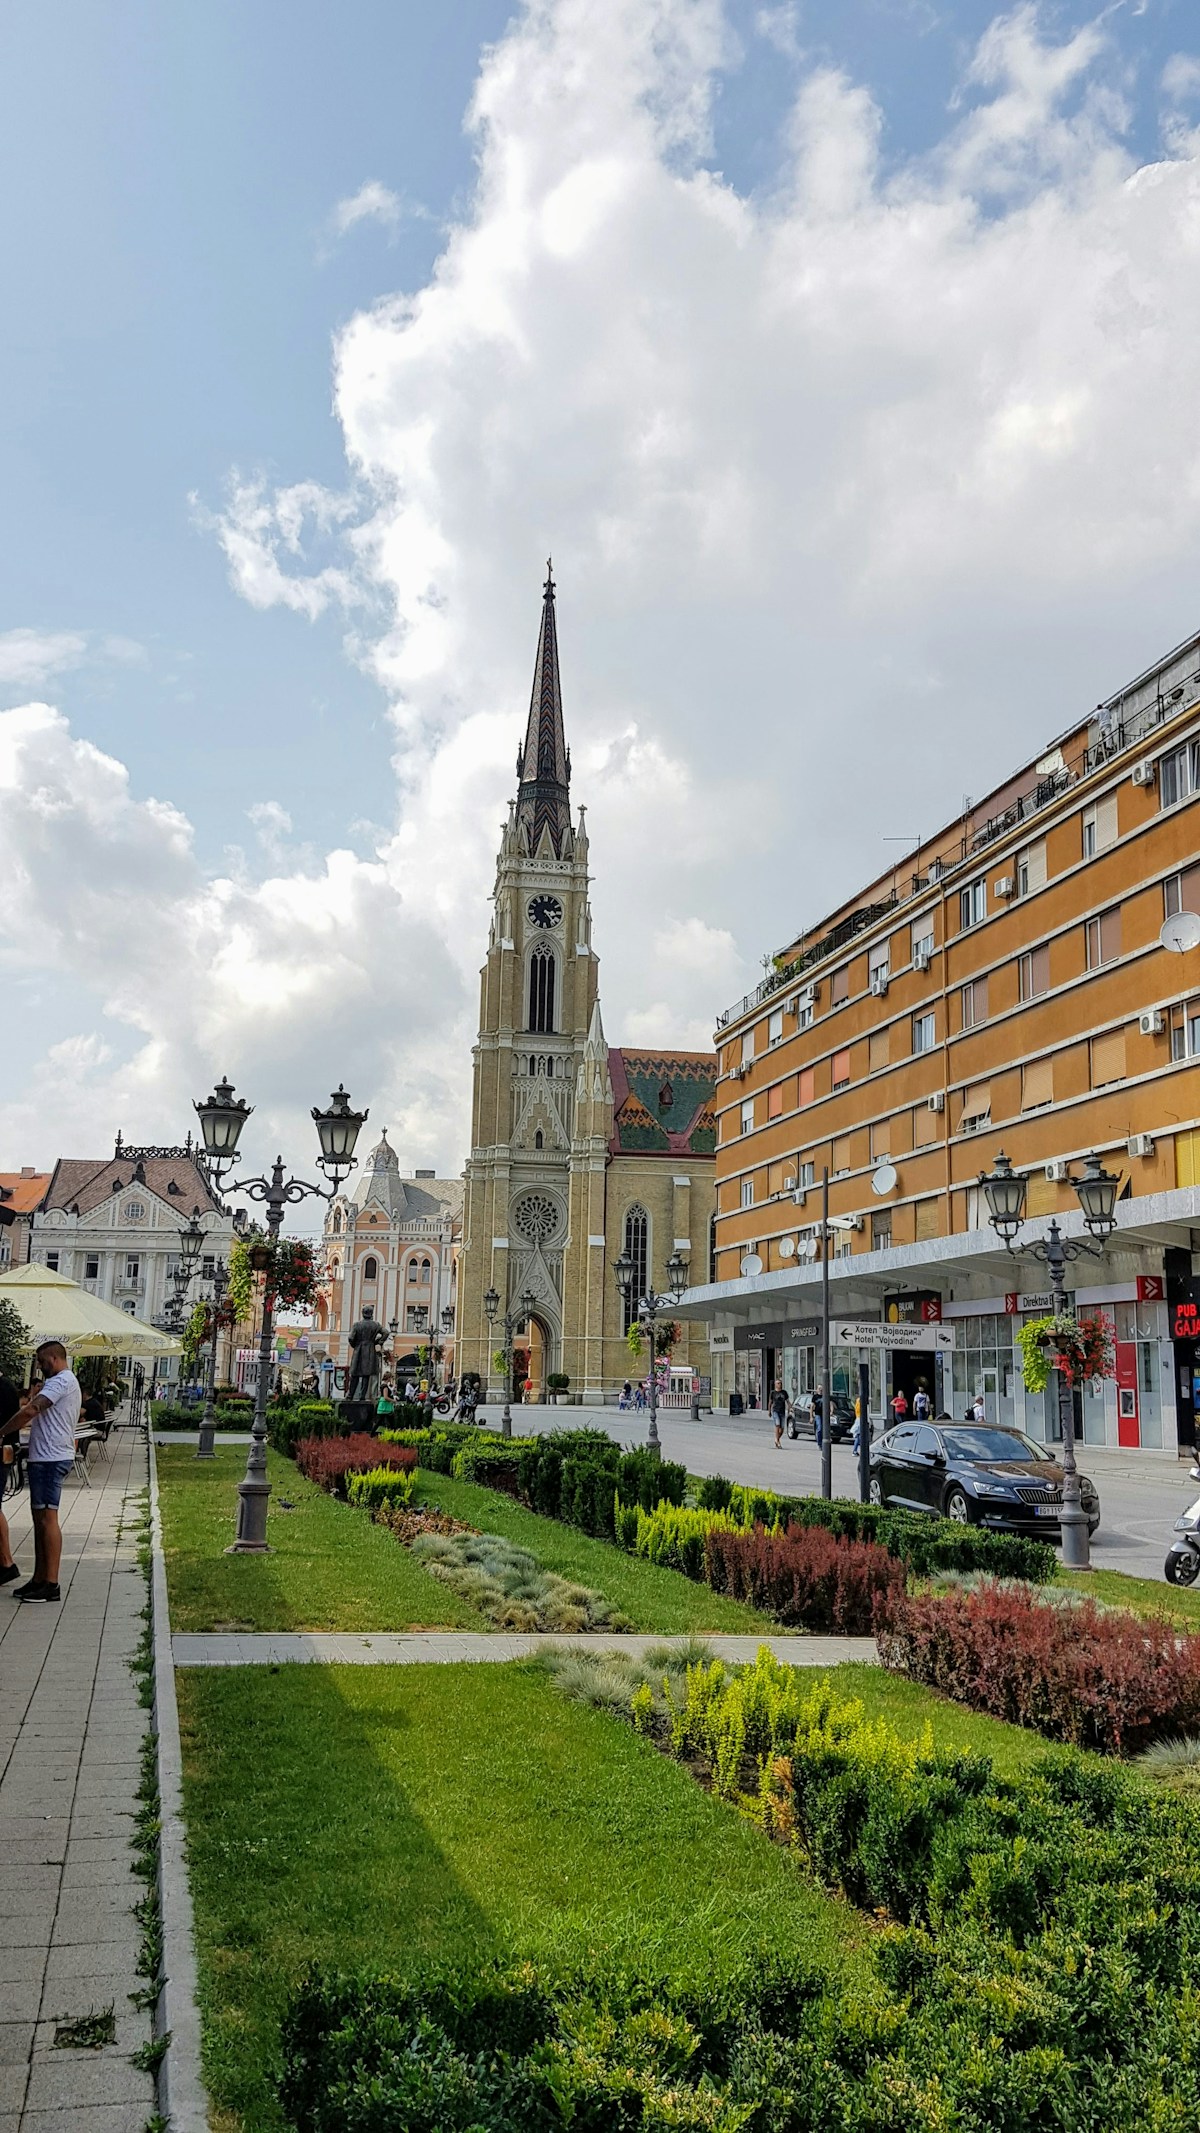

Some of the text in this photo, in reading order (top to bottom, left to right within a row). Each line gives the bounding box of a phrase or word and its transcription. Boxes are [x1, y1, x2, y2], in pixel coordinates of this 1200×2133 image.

[1023, 1294, 1048, 1307] Direktna
[1177, 1304, 1197, 1317] PUB
[855, 1326, 877, 1334] Хотел
[748, 1332, 766, 1340] MAC
[854, 1335, 918, 1346] Hotel "Vojvodina"
